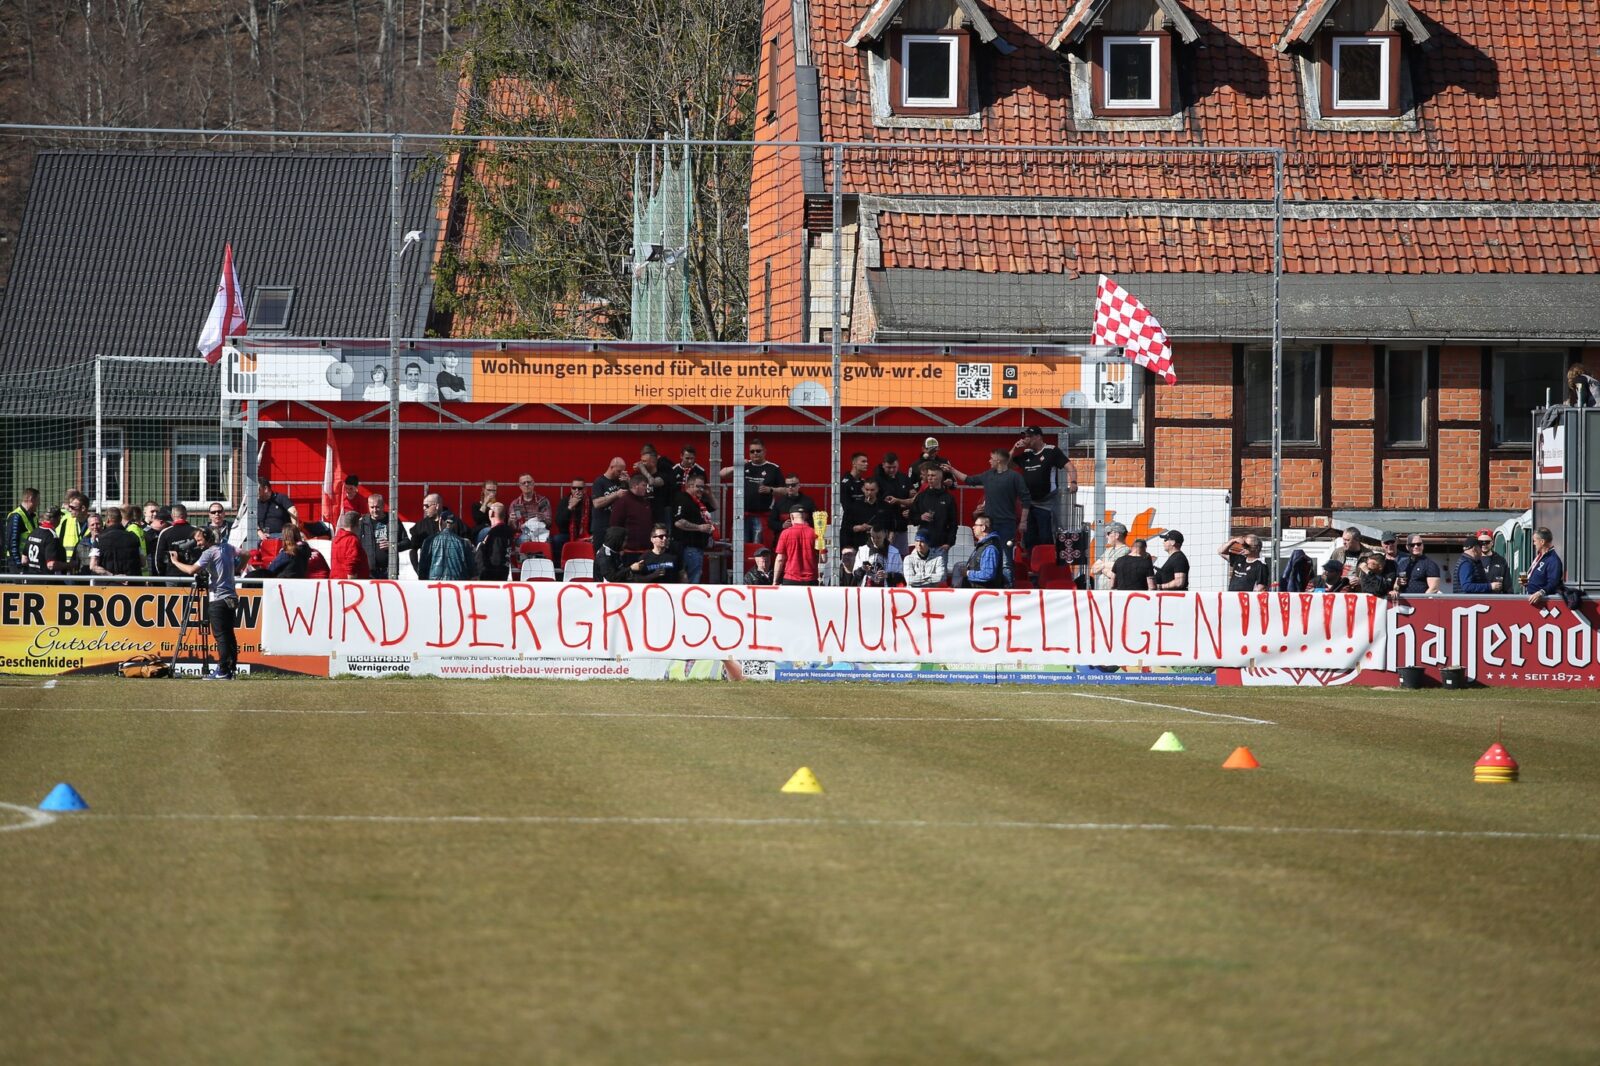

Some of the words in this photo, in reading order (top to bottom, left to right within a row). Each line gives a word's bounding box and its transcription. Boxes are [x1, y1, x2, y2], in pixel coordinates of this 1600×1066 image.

[481, 359, 587, 379] Wohnungen
[593, 361, 665, 379] passend
[670, 361, 695, 376] für
[700, 361, 732, 377] alle
[737, 363, 788, 377] unter
[634, 384, 663, 397] Hier
[667, 384, 707, 400] spielt
[710, 384, 732, 398] die
[736, 384, 791, 399] Zukunft
[28, 544, 40, 563] 62
[278, 579, 409, 647] WIRD
[426, 582, 542, 651] DER
[557, 583, 783, 653] GROSSE
[807, 587, 955, 656] WURF
[28, 626, 157, 658] Gutscheine
[160, 641, 174, 652] für
[243, 642, 255, 652] im
[348, 663, 410, 673] Wernigerode
[440, 664, 629, 676] www.industriebau-wernigerode.de
[780, 671, 809, 679] Ferienpark
[810, 671, 871, 679] Nesseltal-Wernigerode
[949, 673, 979, 681] Ferienpark
[1037, 674, 1072, 682] Wernigerode
[1125, 675, 1212, 683] www.hasseroeder-ferienpark.de
[1524, 673, 1549, 681] SEIT
[1552, 673, 1582, 682] 1872
